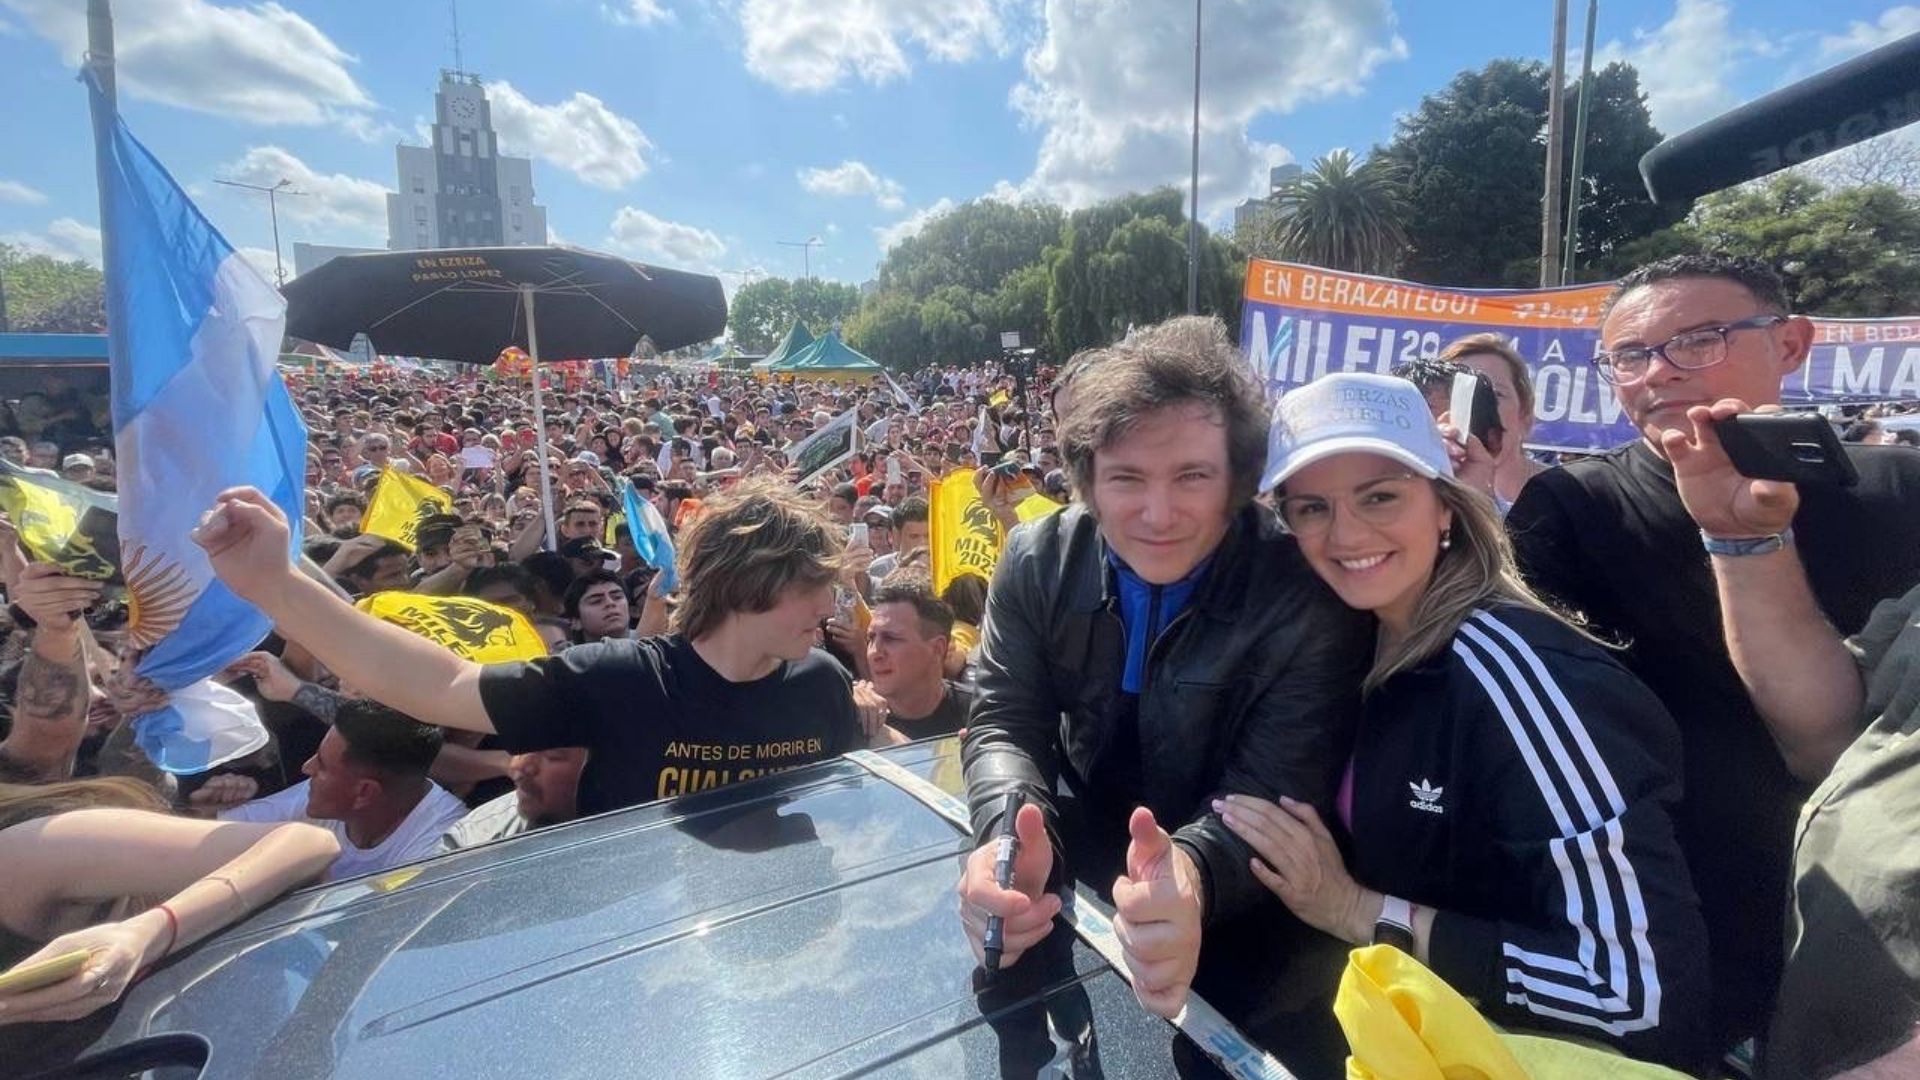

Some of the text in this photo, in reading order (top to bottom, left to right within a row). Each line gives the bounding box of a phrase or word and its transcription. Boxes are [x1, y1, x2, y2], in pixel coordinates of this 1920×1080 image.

[417, 258, 438, 269] EN
[1264, 269, 1291, 298] EN
[1300, 273, 1479, 316] BERAZATEGUI
[1826, 325, 1920, 343] EN BER
[1250, 310, 1441, 382] MILEI 20
[665, 738, 822, 761] ANTES DE MORIR EN
[1410, 800, 1444, 814] adidas
